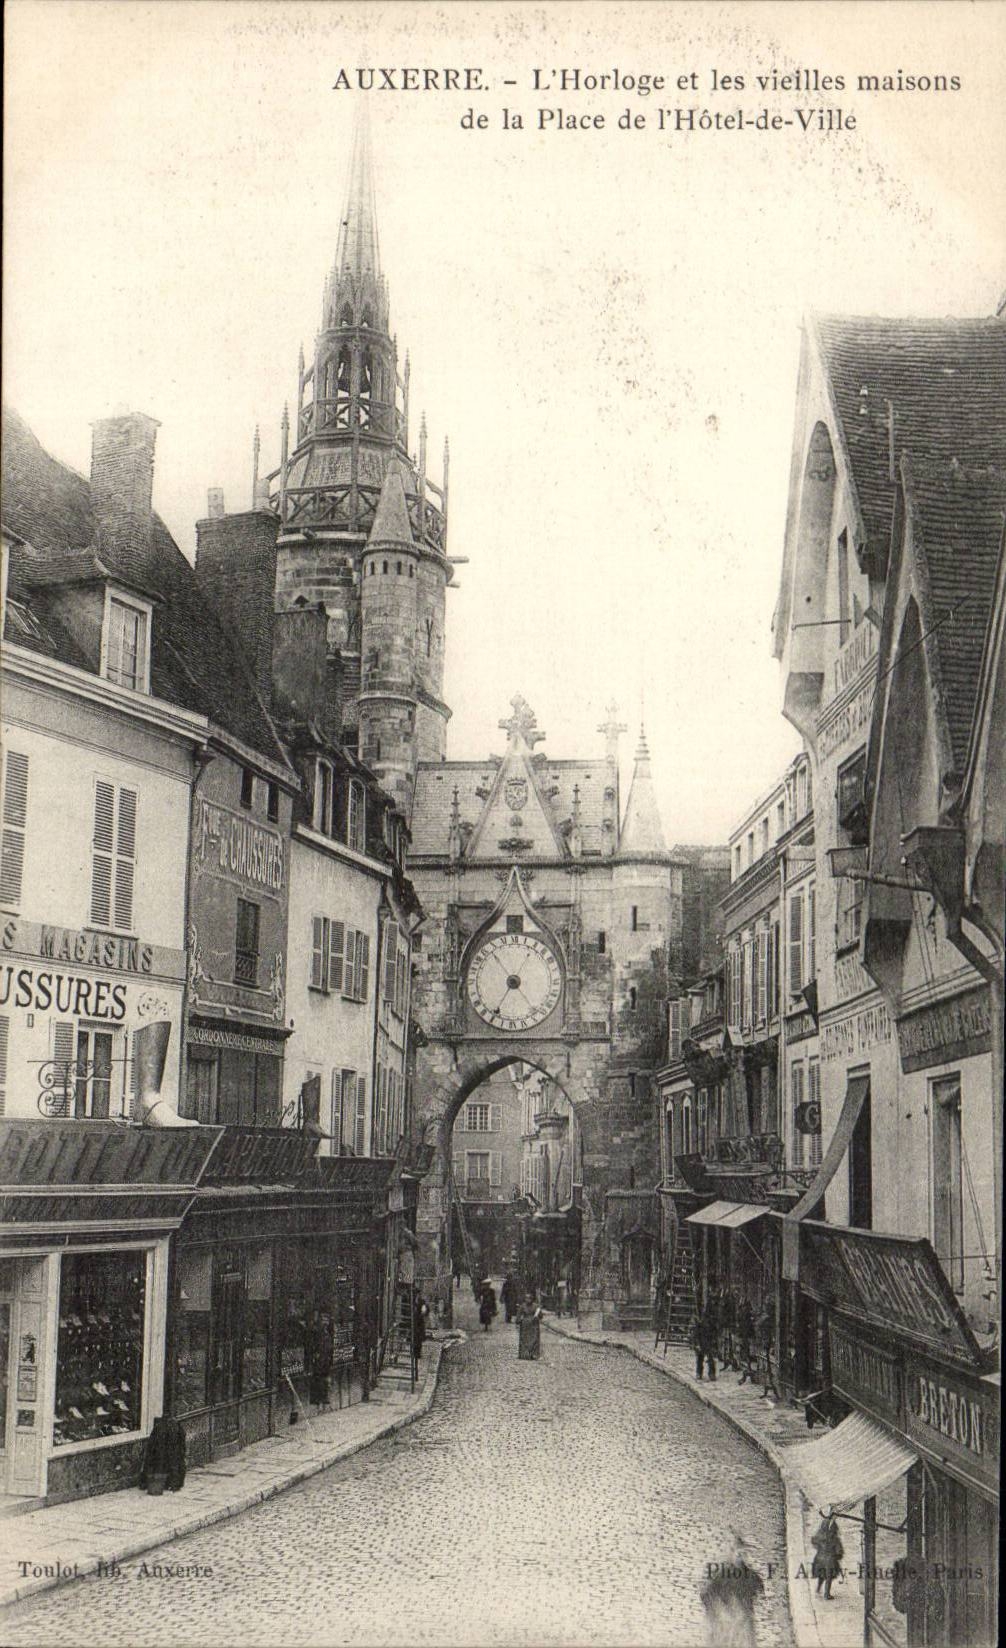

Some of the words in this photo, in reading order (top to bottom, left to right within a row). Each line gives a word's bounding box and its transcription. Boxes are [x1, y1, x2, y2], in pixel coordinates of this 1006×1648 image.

[230, 817, 283, 890] CHAUSSURES
[40, 924, 154, 973] MAGASINS
[804, 1104, 821, 1130] G
[839, 1238, 950, 1328] GRAINES
[919, 1376, 983, 1456] BRETON
